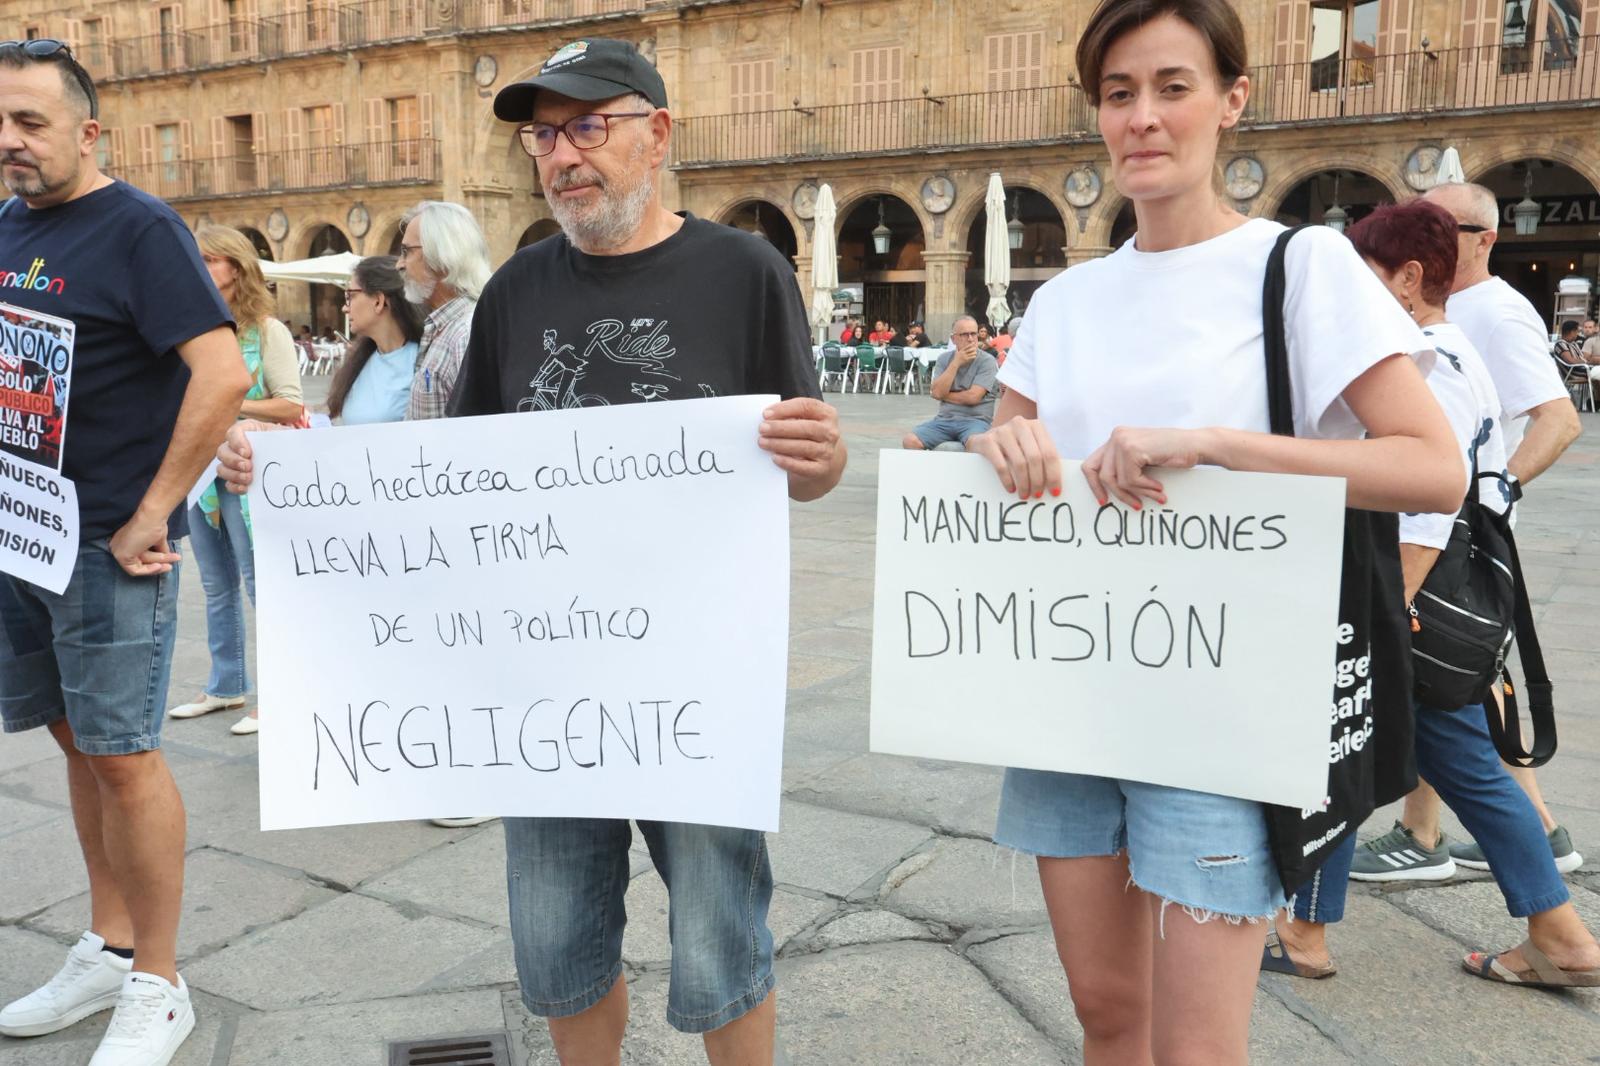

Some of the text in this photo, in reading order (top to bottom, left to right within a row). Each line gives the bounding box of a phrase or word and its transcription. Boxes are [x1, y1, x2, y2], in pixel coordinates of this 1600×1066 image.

[584, 318, 676, 360] Ride
[0, 425, 39, 450] EBLO
[26, 413, 45, 434] AL
[262, 425, 735, 509] Cada hectárea calcinada
[0, 491, 68, 538] ÑONES,
[901, 493, 1082, 548] MAÑUECO,
[290, 512, 569, 578] LLEVA LA FIRMA
[369, 595, 650, 647] DE UN POLÍTICO
